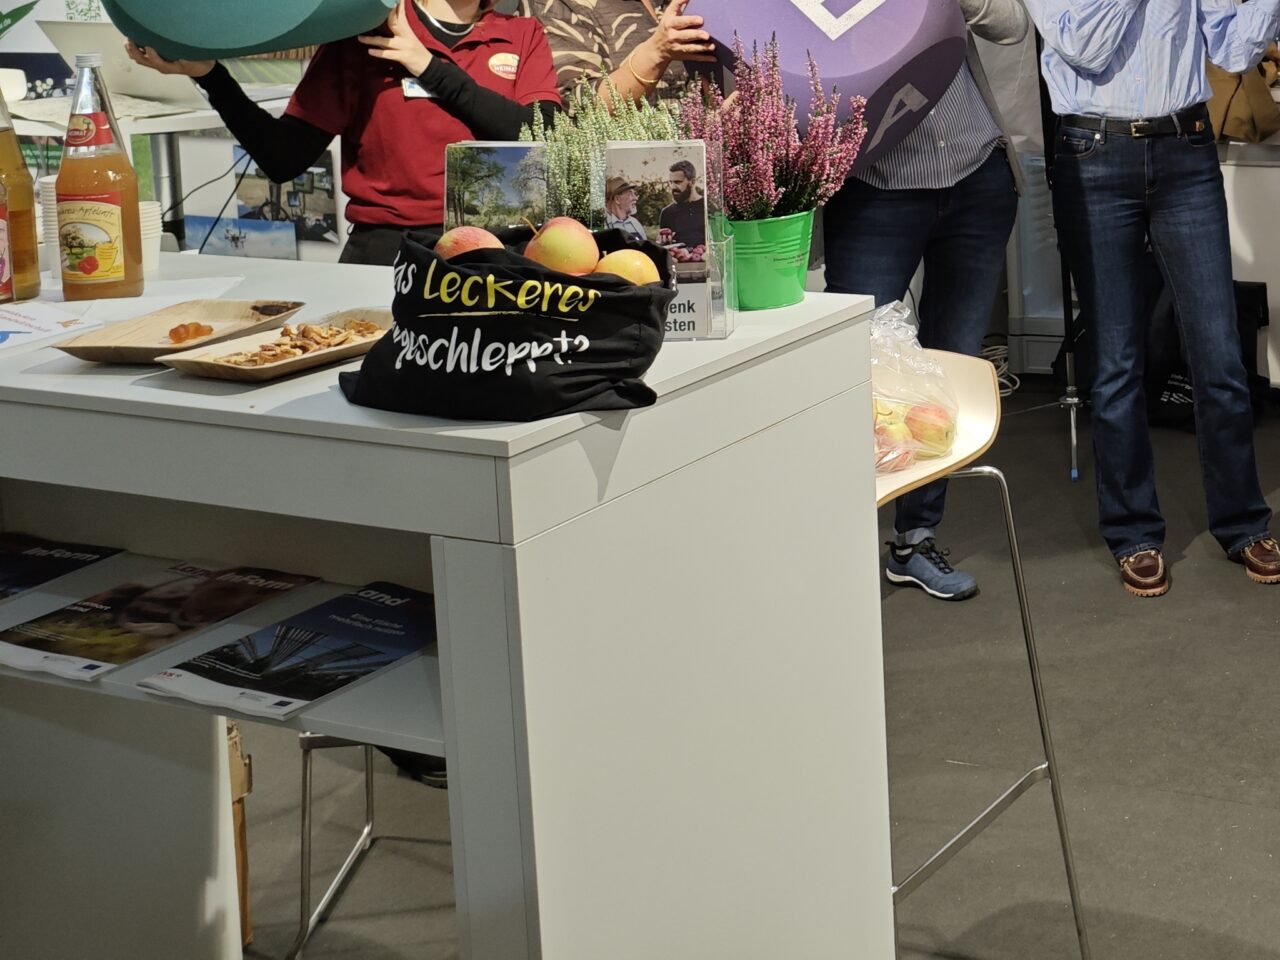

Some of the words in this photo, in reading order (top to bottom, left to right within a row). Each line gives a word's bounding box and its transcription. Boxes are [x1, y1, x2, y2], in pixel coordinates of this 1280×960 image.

[423, 258, 601, 313] Leckeres
[668, 300, 696, 314] enk
[664, 319, 696, 332] sten
[215, 572, 296, 591] InForm
